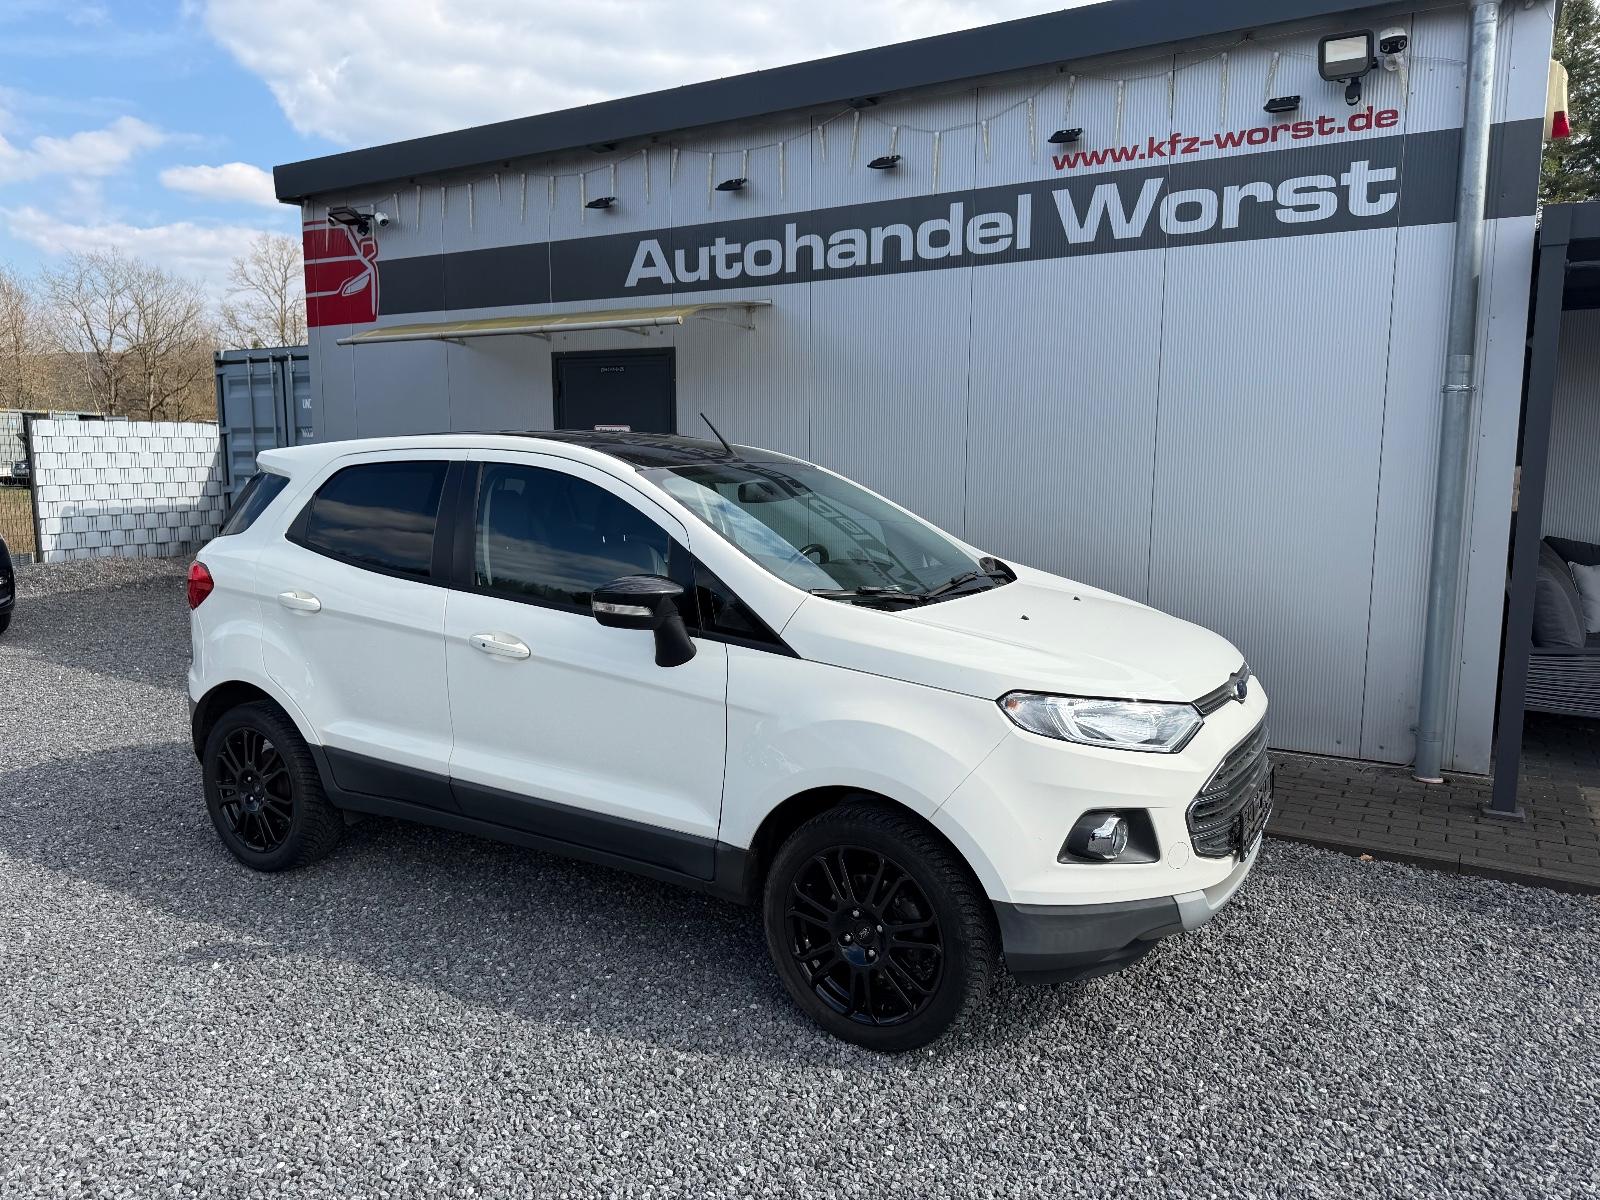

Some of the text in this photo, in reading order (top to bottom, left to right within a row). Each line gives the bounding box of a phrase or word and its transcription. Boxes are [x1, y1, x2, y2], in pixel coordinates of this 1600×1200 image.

[1052, 106, 1399, 170] www.kfz-worst.de
[624, 160, 1397, 287] Autohandel Worst
